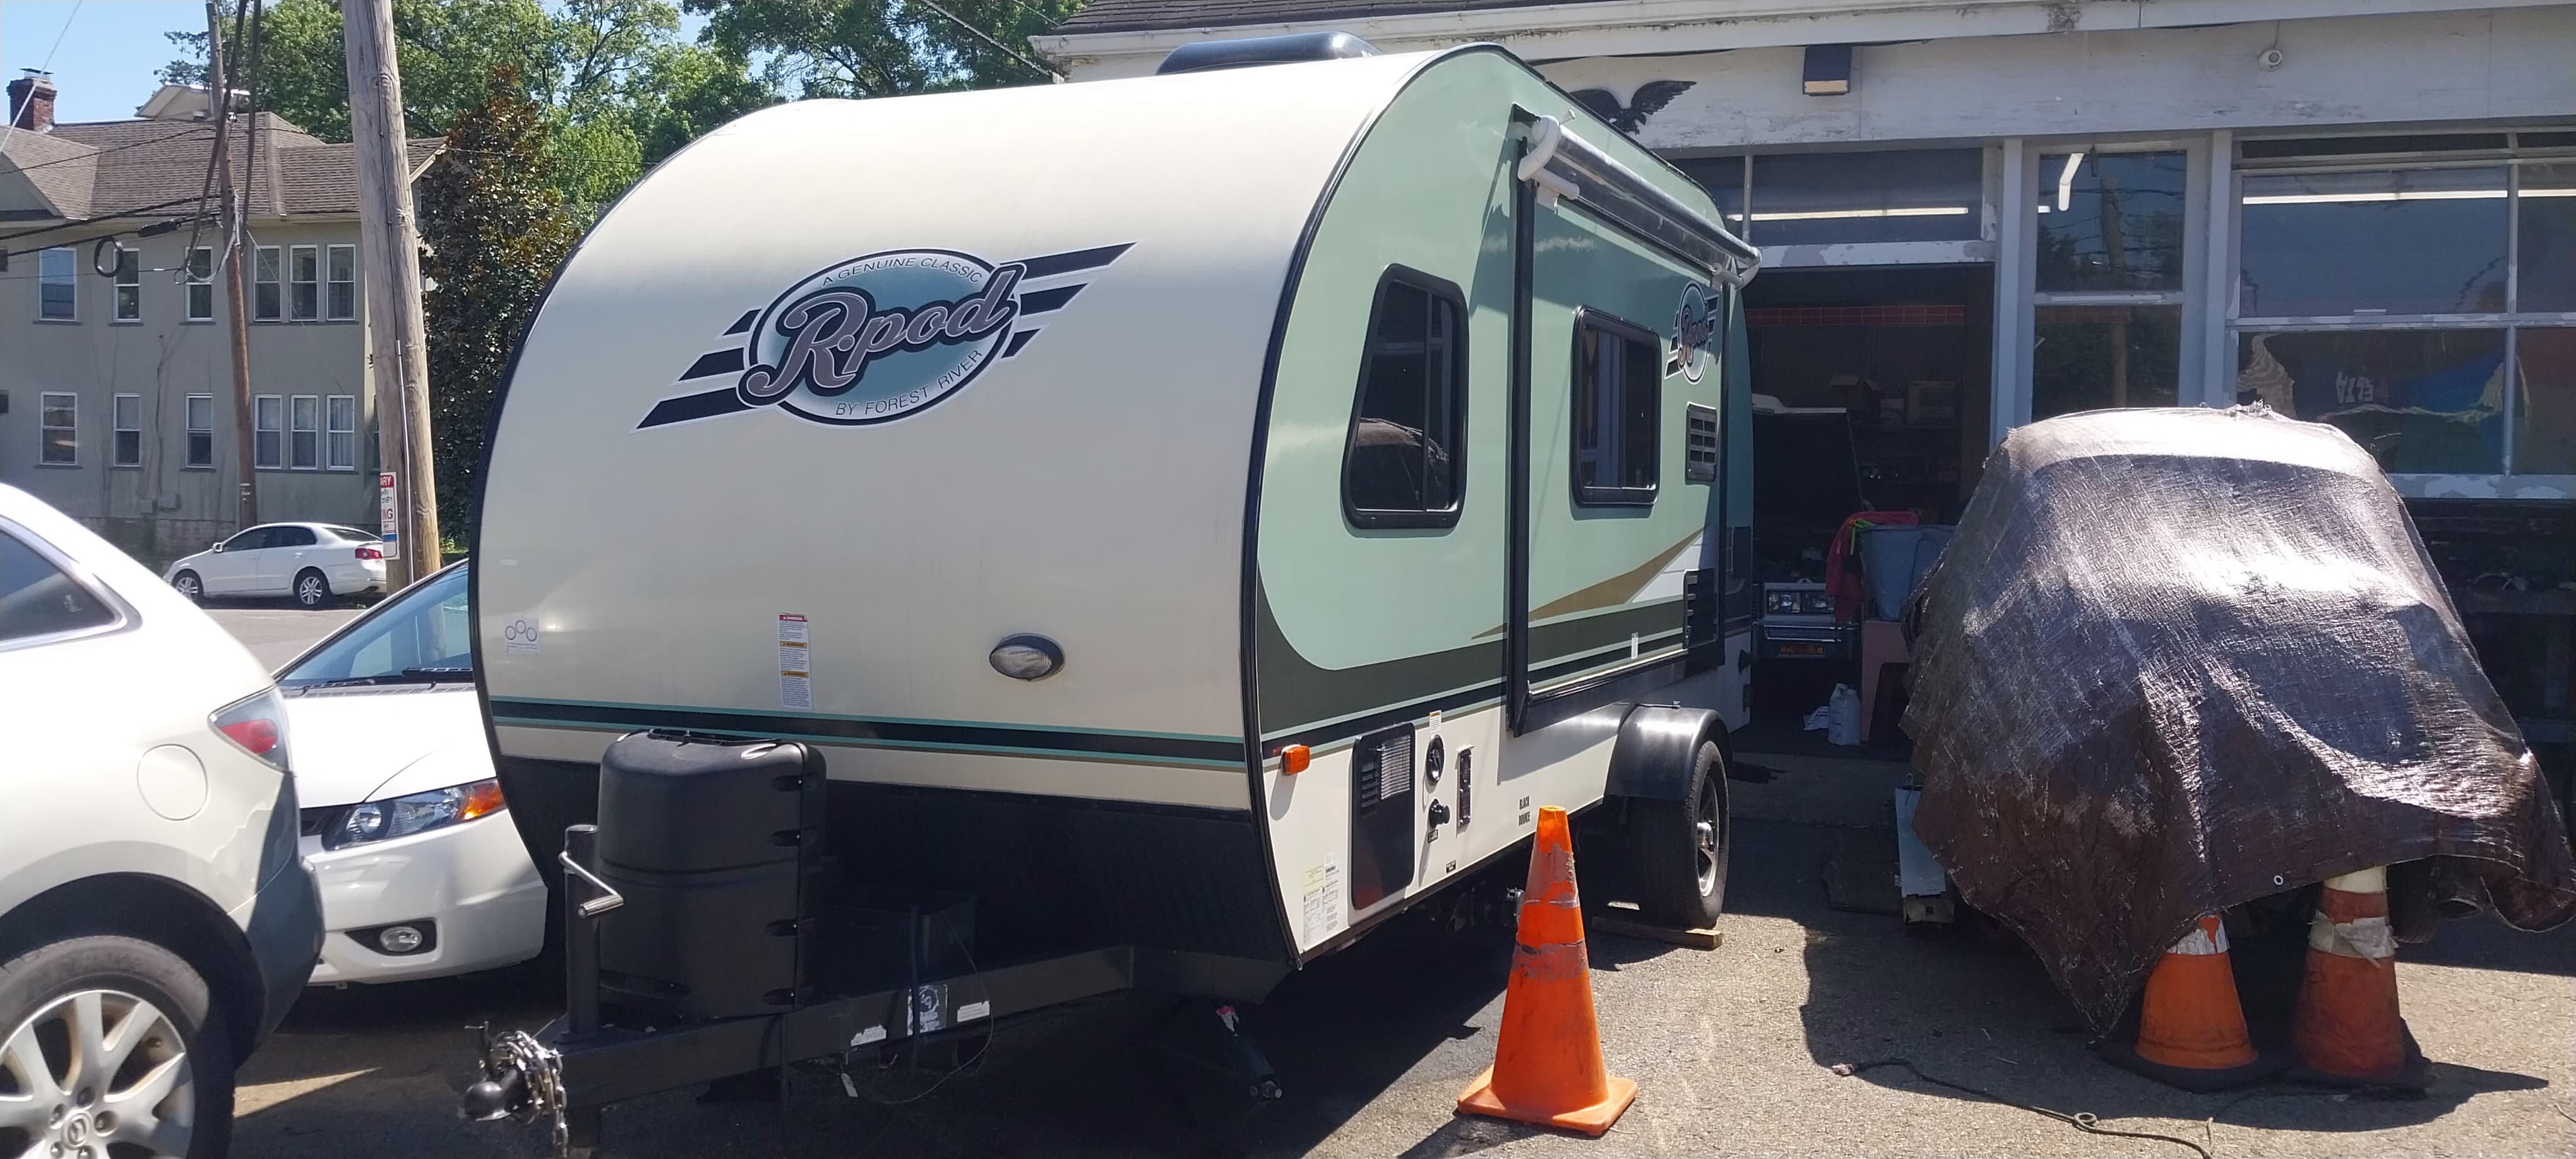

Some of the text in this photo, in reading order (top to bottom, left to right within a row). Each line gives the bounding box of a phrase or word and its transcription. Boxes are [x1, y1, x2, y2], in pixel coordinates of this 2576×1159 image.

[823, 258, 982, 287] A GENUINE CLASSIC
[835, 350, 982, 415] BY FOREST RIVER
[1519, 795, 1529, 810] BLACK
